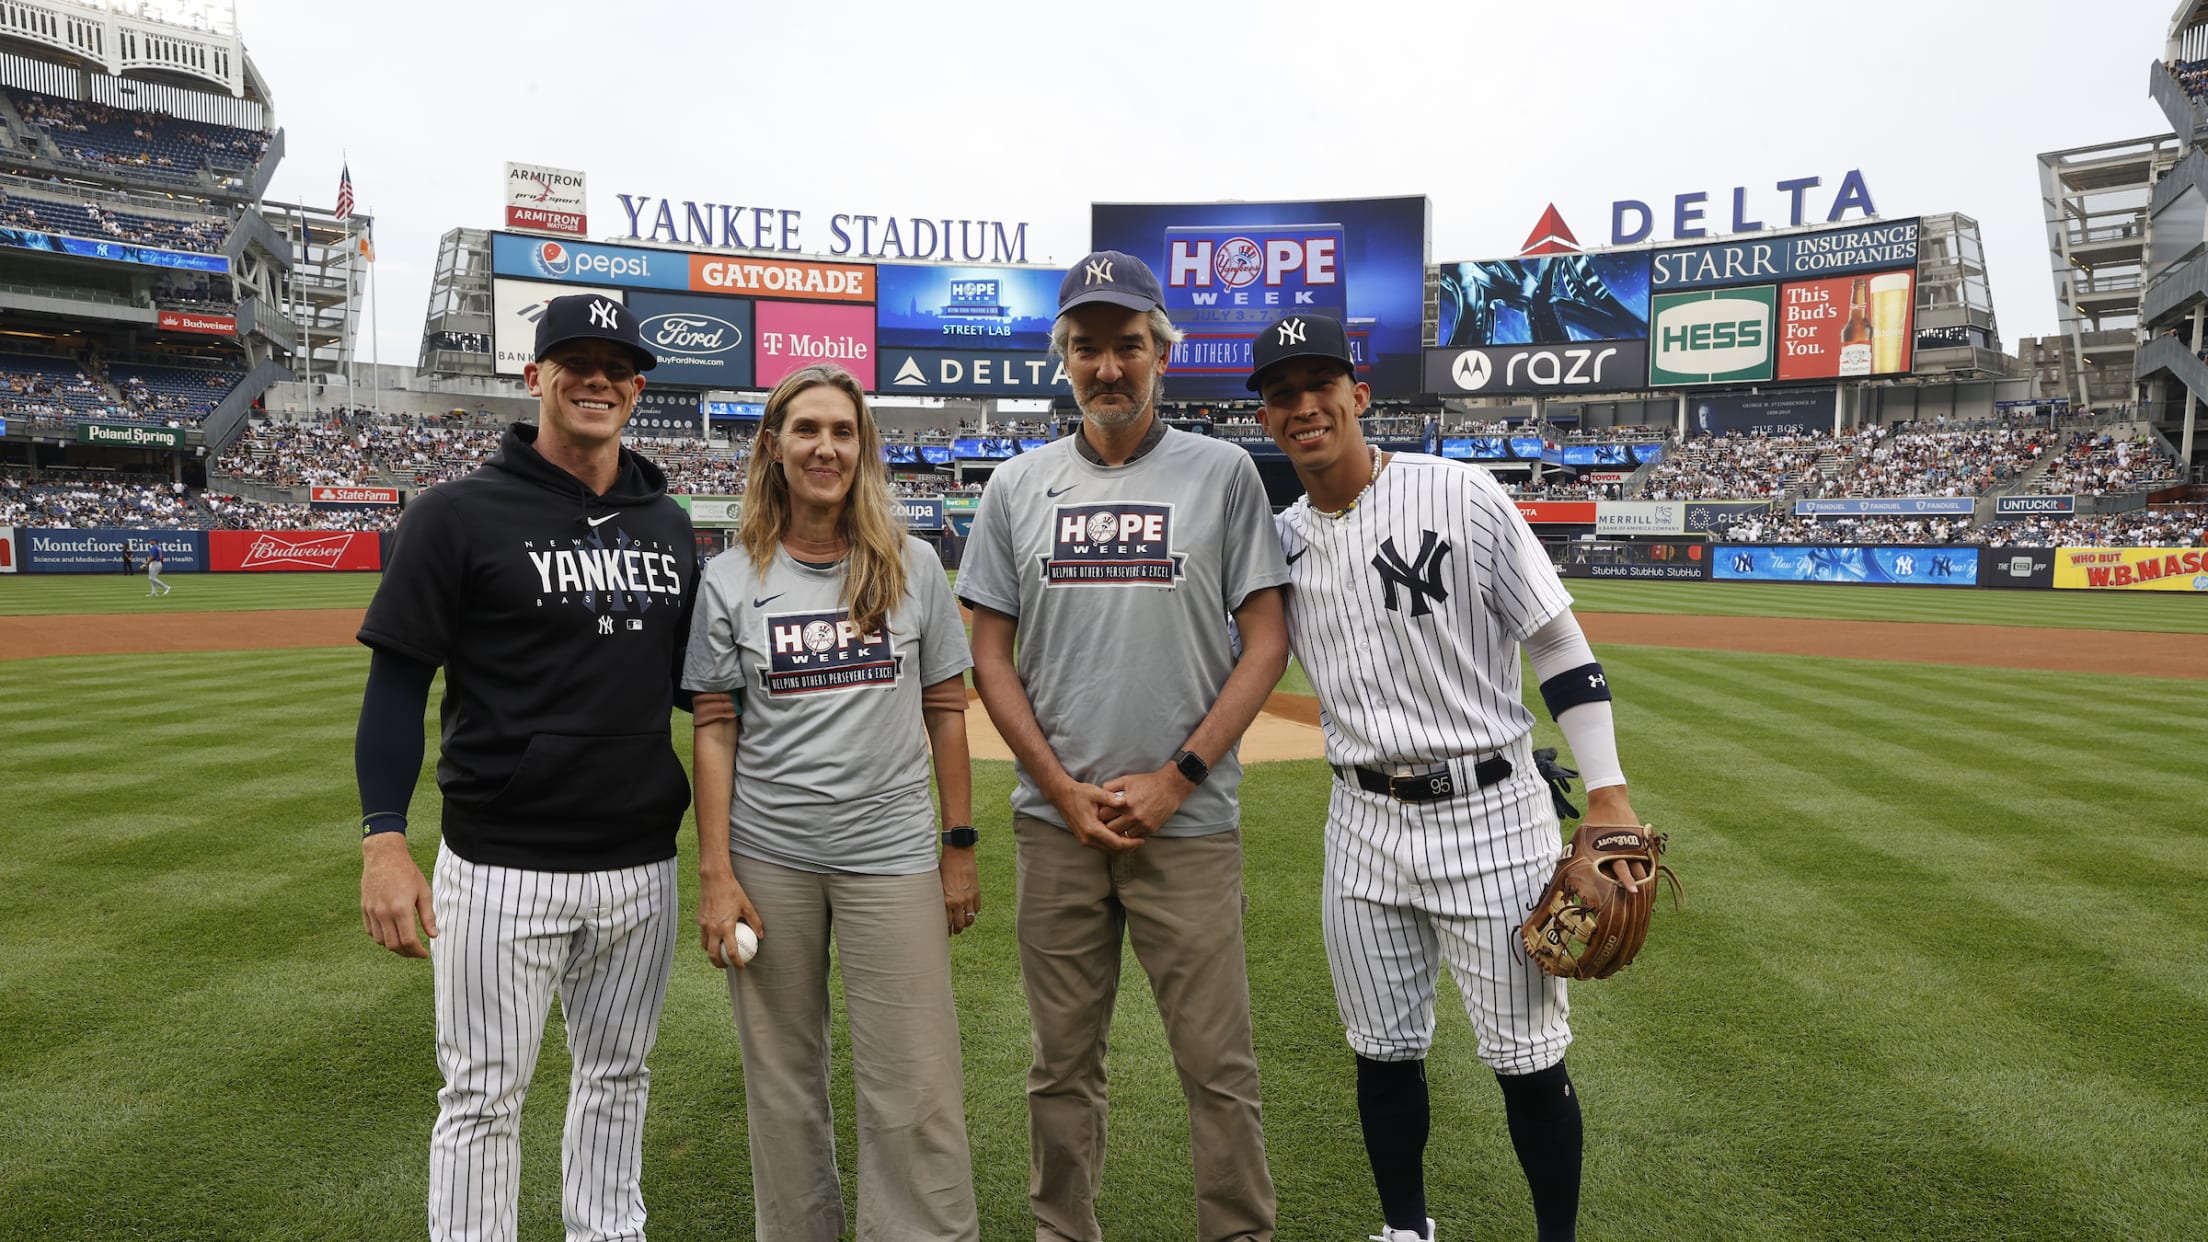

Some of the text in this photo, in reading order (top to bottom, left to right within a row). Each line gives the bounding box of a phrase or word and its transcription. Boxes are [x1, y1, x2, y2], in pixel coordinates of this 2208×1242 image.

[510, 169, 582, 187] ARMITRON
[1611, 169, 1877, 245] DELTA
[515, 210, 580, 226] ARMITRON
[547, 222, 578, 232] WATCHES
[616, 193, 1030, 263] YANKEE STADIUM
[1796, 224, 1918, 256] INSURANCE
[1653, 244, 1780, 285] STARR
[1795, 241, 1917, 272] COMPANIES
[574, 253, 649, 279] pepsi
[702, 262, 863, 295] GATORADE
[1192, 290, 1315, 306] WEEK
[1787, 286, 1829, 304] This
[1192, 310, 1231, 321] JULY
[1787, 303, 1838, 321] Bud's
[183, 318, 234, 331] Budweiser
[943, 324, 1011, 336] STREET LAB
[1786, 323, 1818, 339] For
[656, 317, 725, 349] Ford
[1663, 319, 1762, 352] HESS
[789, 334, 868, 360] Mobile
[1194, 343, 1239, 364] OTHERS
[1785, 340, 1825, 356] You.
[498, 351, 535, 362] BANK
[656, 355, 724, 367] BuyFordNow.com
[940, 358, 1073, 386] DELTA
[1507, 348, 1617, 386] razr
[89, 425, 175, 446] Poland Spring
[1777, 423, 1804, 433] BOSS
[1520, 508, 1537, 516] OTA
[1870, 502, 1902, 510] FANDUEL
[1926, 502, 1960, 510] FANDUEL
[2003, 499, 2058, 510] UNTUCKit
[1599, 515, 1652, 524] MERRILL
[33, 537, 193, 552] Montefiore Eintein
[250, 541, 345, 559] Budweiser
[525, 538, 673, 551] NEW YORK
[1073, 544, 1149, 554] WEEK
[2071, 553, 2122, 565] WHO BUT
[528, 549, 681, 595] YANKEES
[1052, 565, 1169, 578] HELPING OTHERS PERSEVERE & EXCEL
[1591, 566, 1702, 578] StubHub StubHub StubHub
[792, 648, 871, 664] WEEK
[772, 667, 893, 690] HELPING OTHERS PERSEVERE & EXCEL
[1430, 775, 1450, 795] 95
[1596, 834, 1640, 849] Wilson
